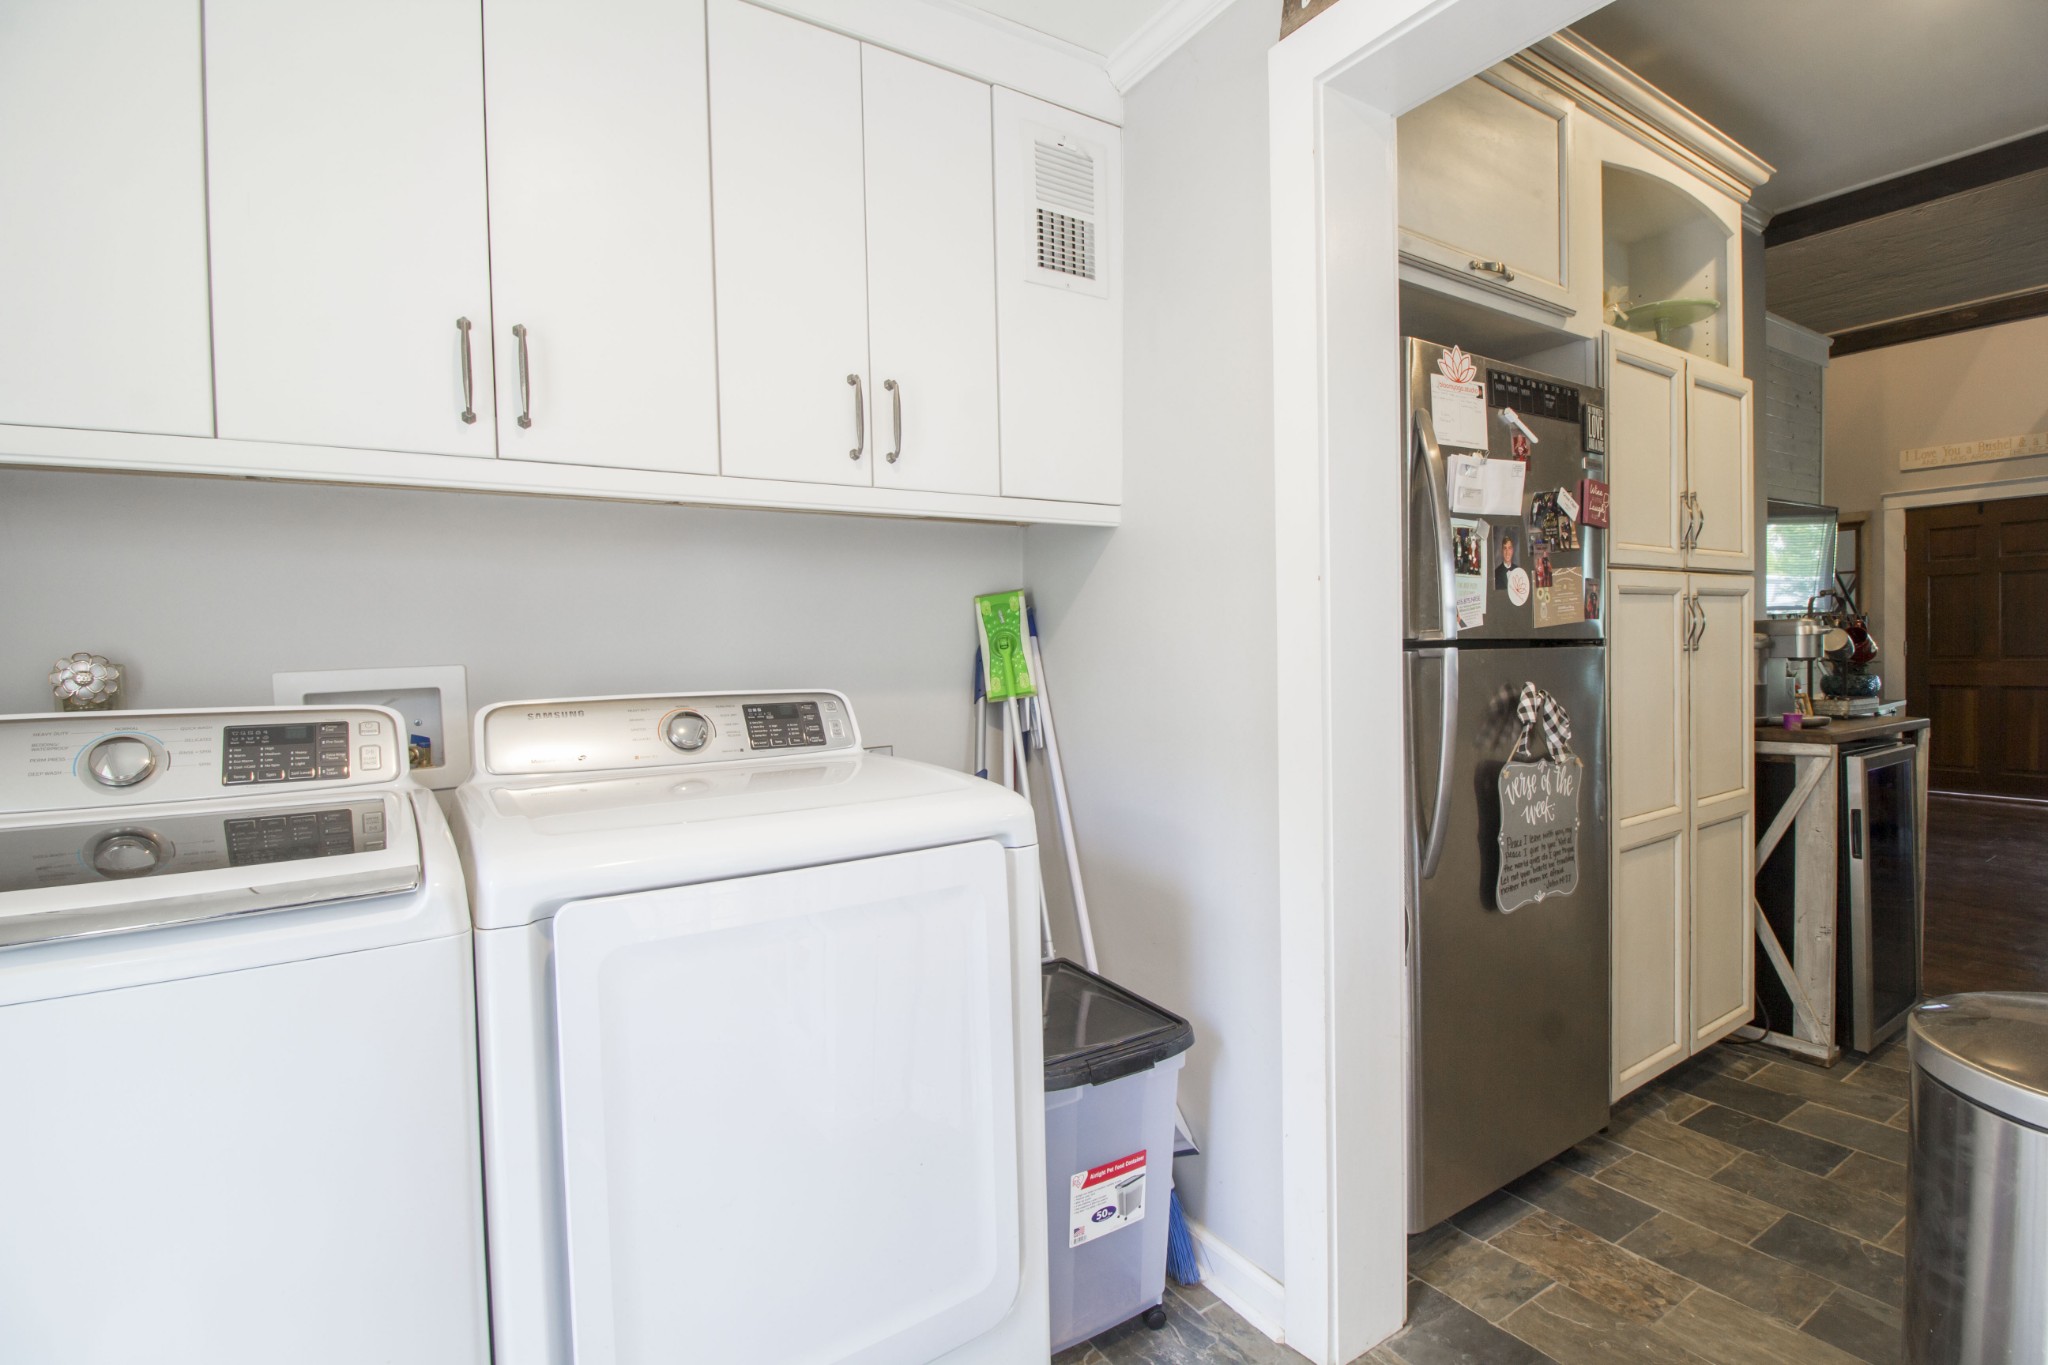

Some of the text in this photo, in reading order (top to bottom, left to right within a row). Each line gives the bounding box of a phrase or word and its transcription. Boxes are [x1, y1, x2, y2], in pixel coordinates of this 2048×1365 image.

[1588, 413, 1604, 441] LOVE
[1914, 449, 1937, 461] Love
[1941, 445, 1961, 457] You
[1977, 438, 2012, 452] Bushel
[1589, 484, 1603, 497] Wine
[527, 710, 585, 720] SAMSUNG
[1505, 765, 1574, 805] verse of the
[1506, 836, 1522, 851] Peace
[1089, 1155, 1145, 1181] Airtight Pet Food Container
[1095, 1208, 1108, 1220] 50
